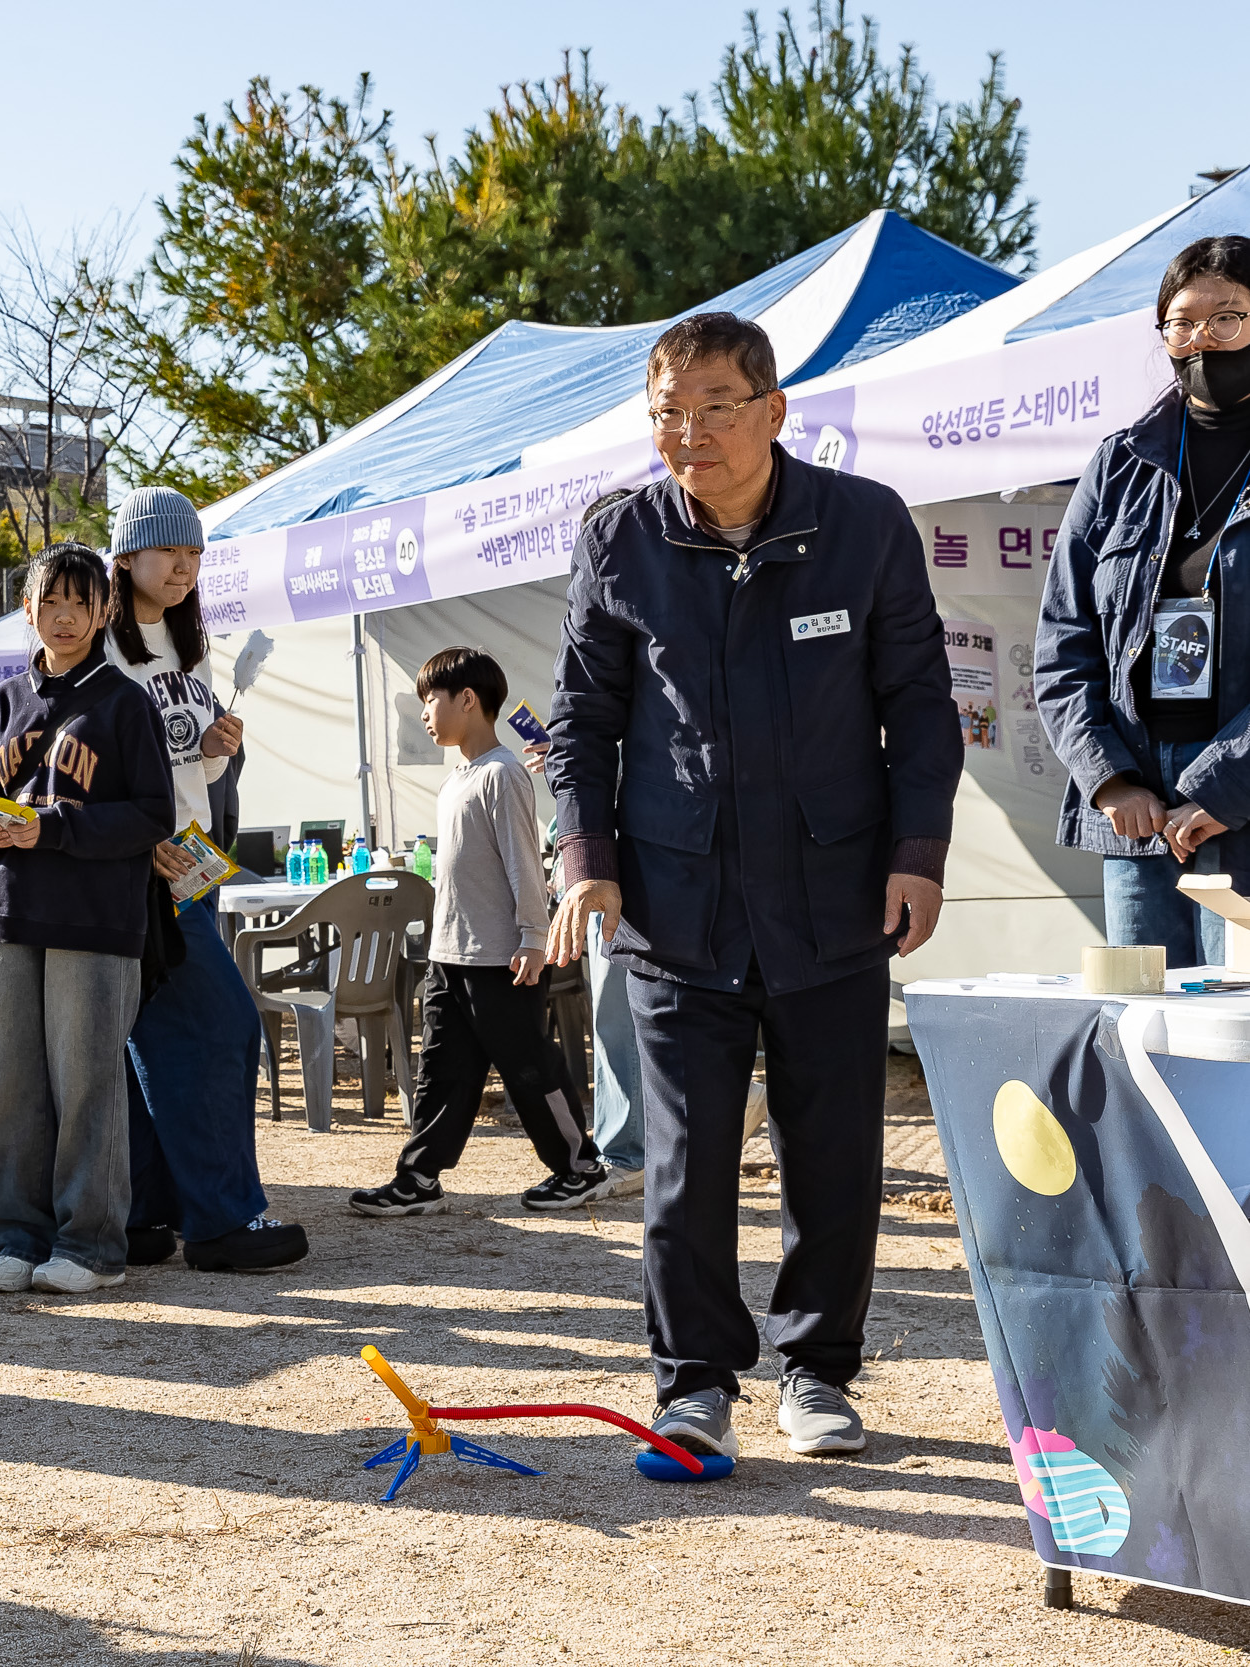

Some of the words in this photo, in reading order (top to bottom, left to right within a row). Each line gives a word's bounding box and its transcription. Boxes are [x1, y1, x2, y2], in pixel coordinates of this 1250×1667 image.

[922, 397, 1005, 450] 양성평등
[1009, 375, 1100, 431] 스테이션
[818, 439, 839, 465] 41
[480, 493, 522, 528] 고르고
[525, 483, 555, 518] 바다
[354, 545, 386, 573] 청소년
[400, 541, 415, 561] 40
[207, 569, 249, 597] 작은도서관
[352, 572, 396, 600] 페스티벌
[1159, 634, 1206, 657] STAFF
